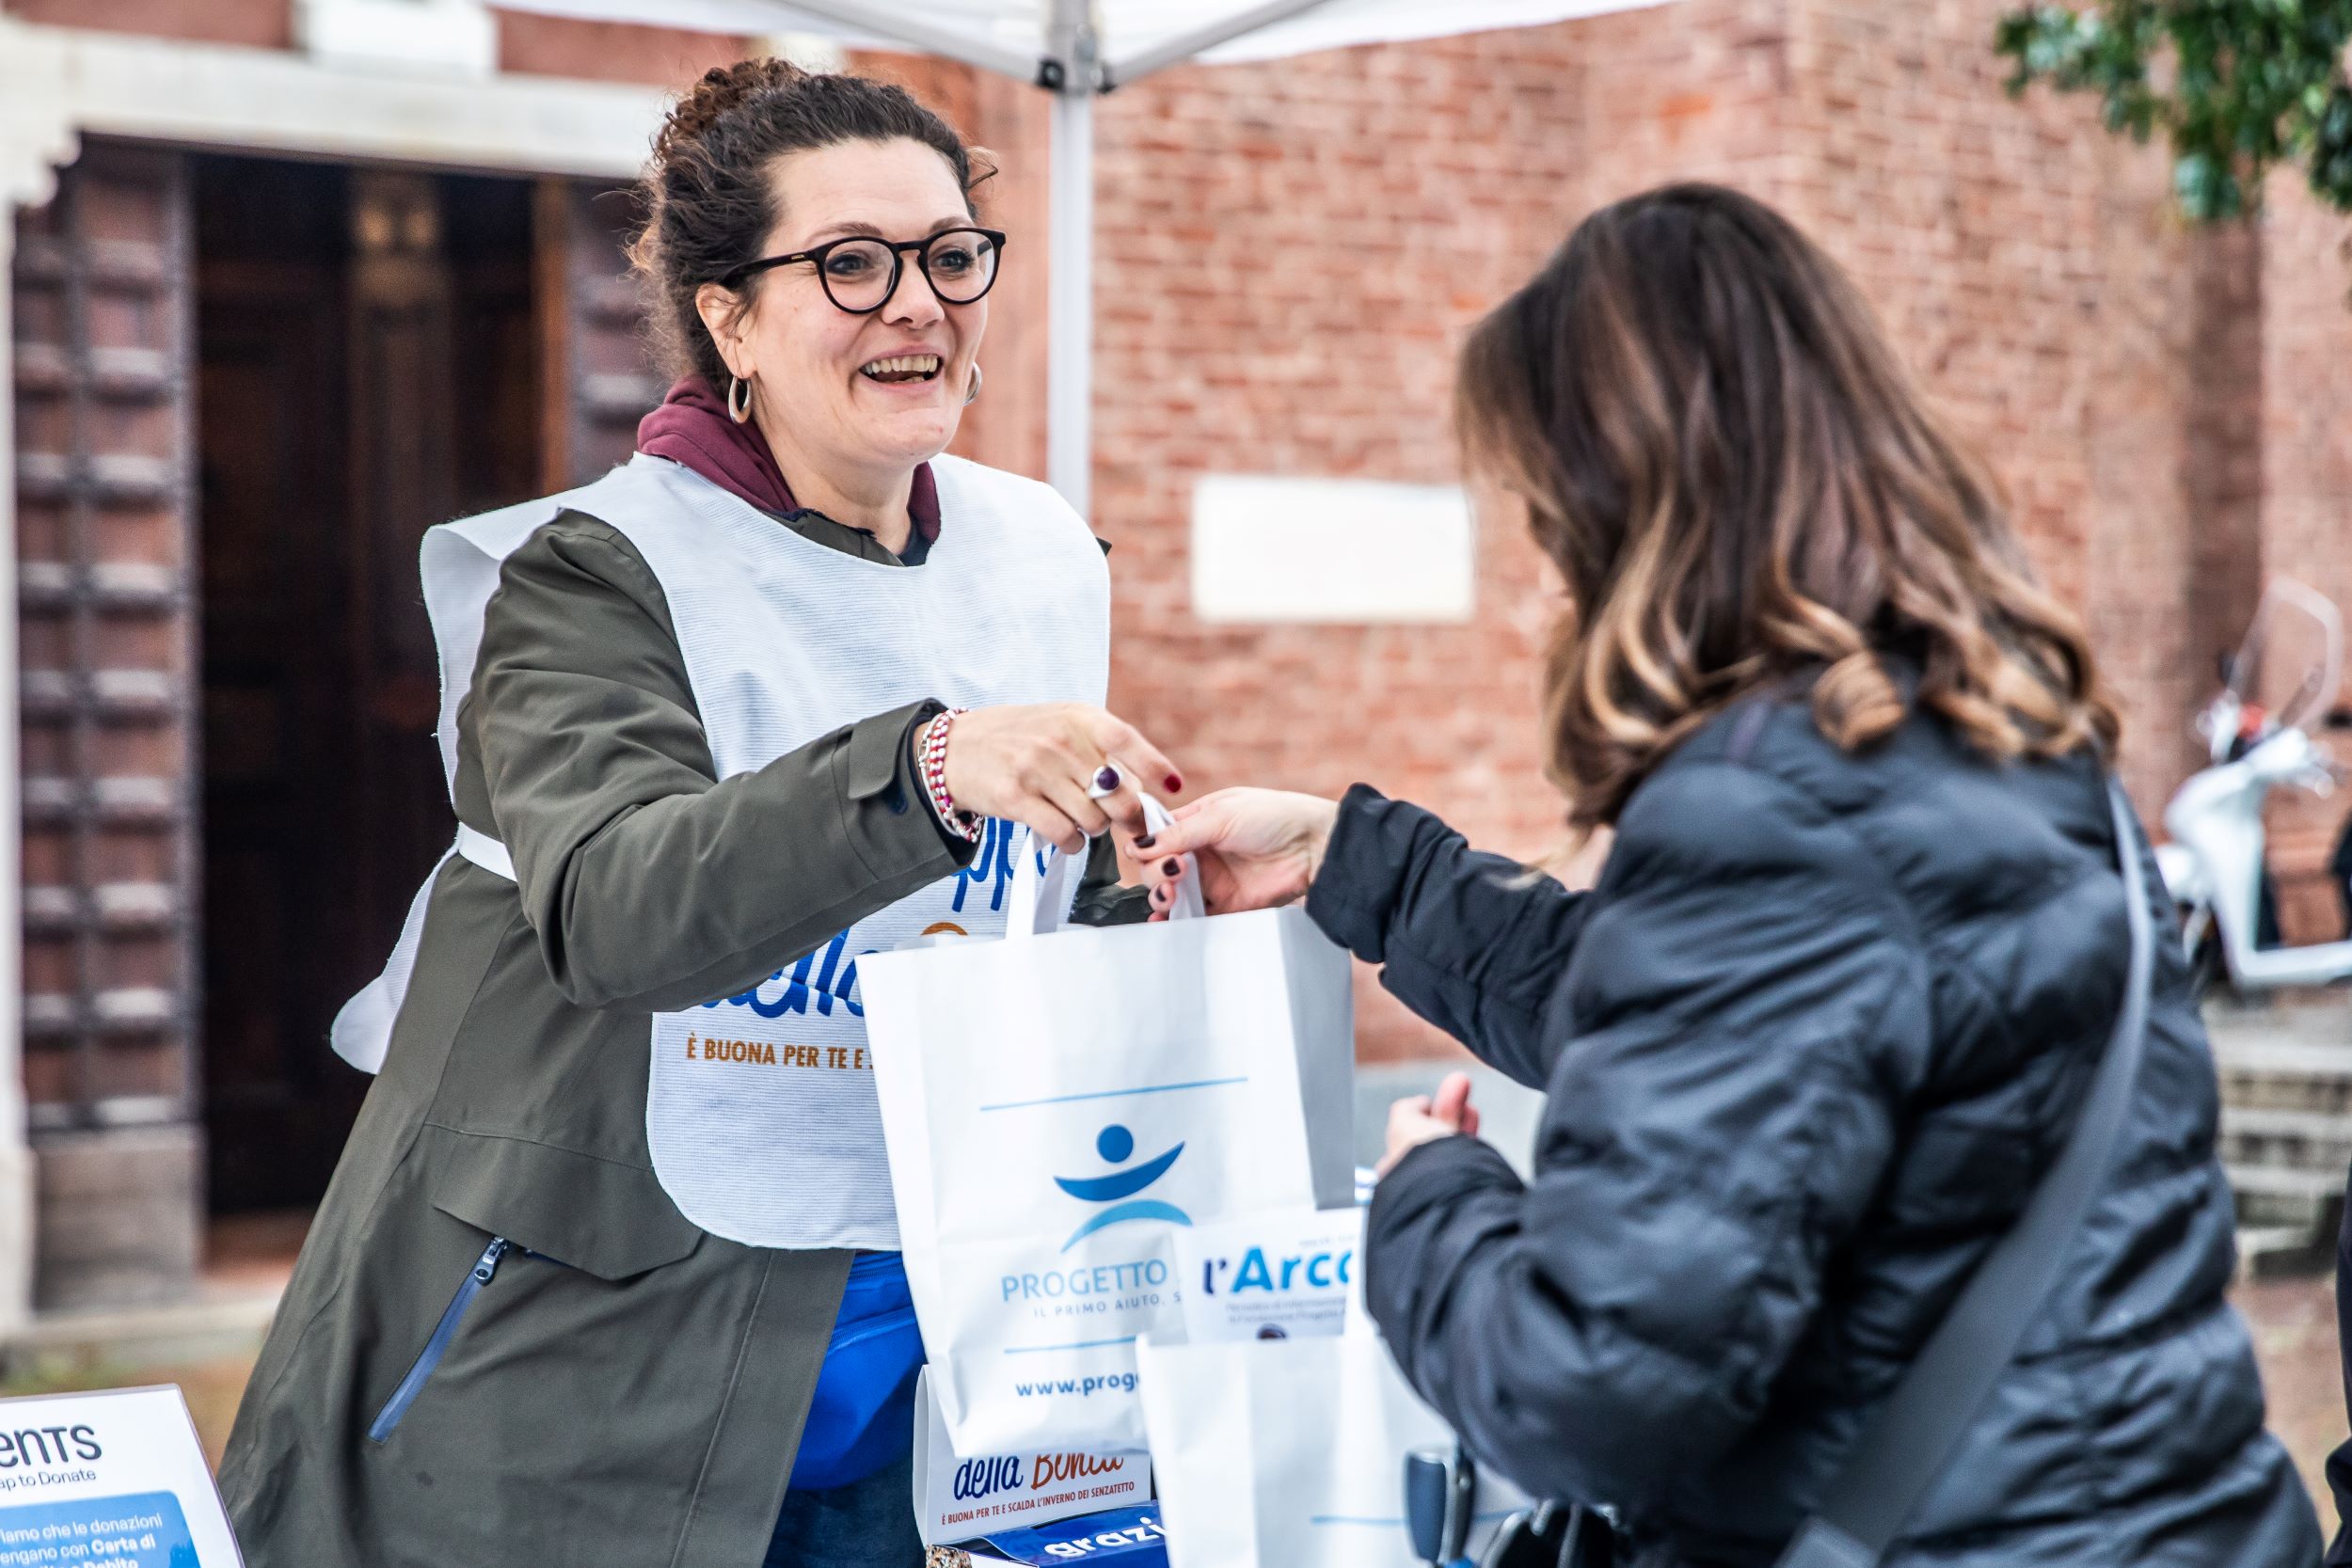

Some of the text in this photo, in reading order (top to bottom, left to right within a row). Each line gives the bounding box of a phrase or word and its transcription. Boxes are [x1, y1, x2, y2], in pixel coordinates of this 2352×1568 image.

[687, 1031, 698, 1060] È
[704, 1037, 776, 1066] BUONA
[783, 1043, 819, 1069] PER
[826, 1046, 848, 1069] TE
[853, 1048, 865, 1069] E
[1001, 1258, 1168, 1303] PROGETTO
[1054, 1300, 1107, 1317] PRIMO
[1114, 1292, 1166, 1310] AIUTO.
[1015, 1371, 1138, 1397] www.prog
[18, 1473, 37, 1487] to
[39, 1467, 97, 1485] Donate
[954, 1455, 1024, 1501] della
[947, 1510, 975, 1525] BUONA
[976, 1507, 990, 1519] PER
[992, 1504, 1000, 1516] TE
[1002, 1503, 1007, 1514] E
[1008, 1498, 1036, 1513] SCALDA
[1037, 1491, 1076, 1508] L'INVERNO
[1078, 1488, 1089, 1500] DEI
[1091, 1481, 1135, 1498] SENZATETTO
[42, 1523, 72, 1541] che
[72, 1520, 88, 1536] le
[90, 1513, 163, 1533] donazioni
[60, 1543, 90, 1559] con
[91, 1535, 138, 1555] Carta
[140, 1532, 157, 1550] di
